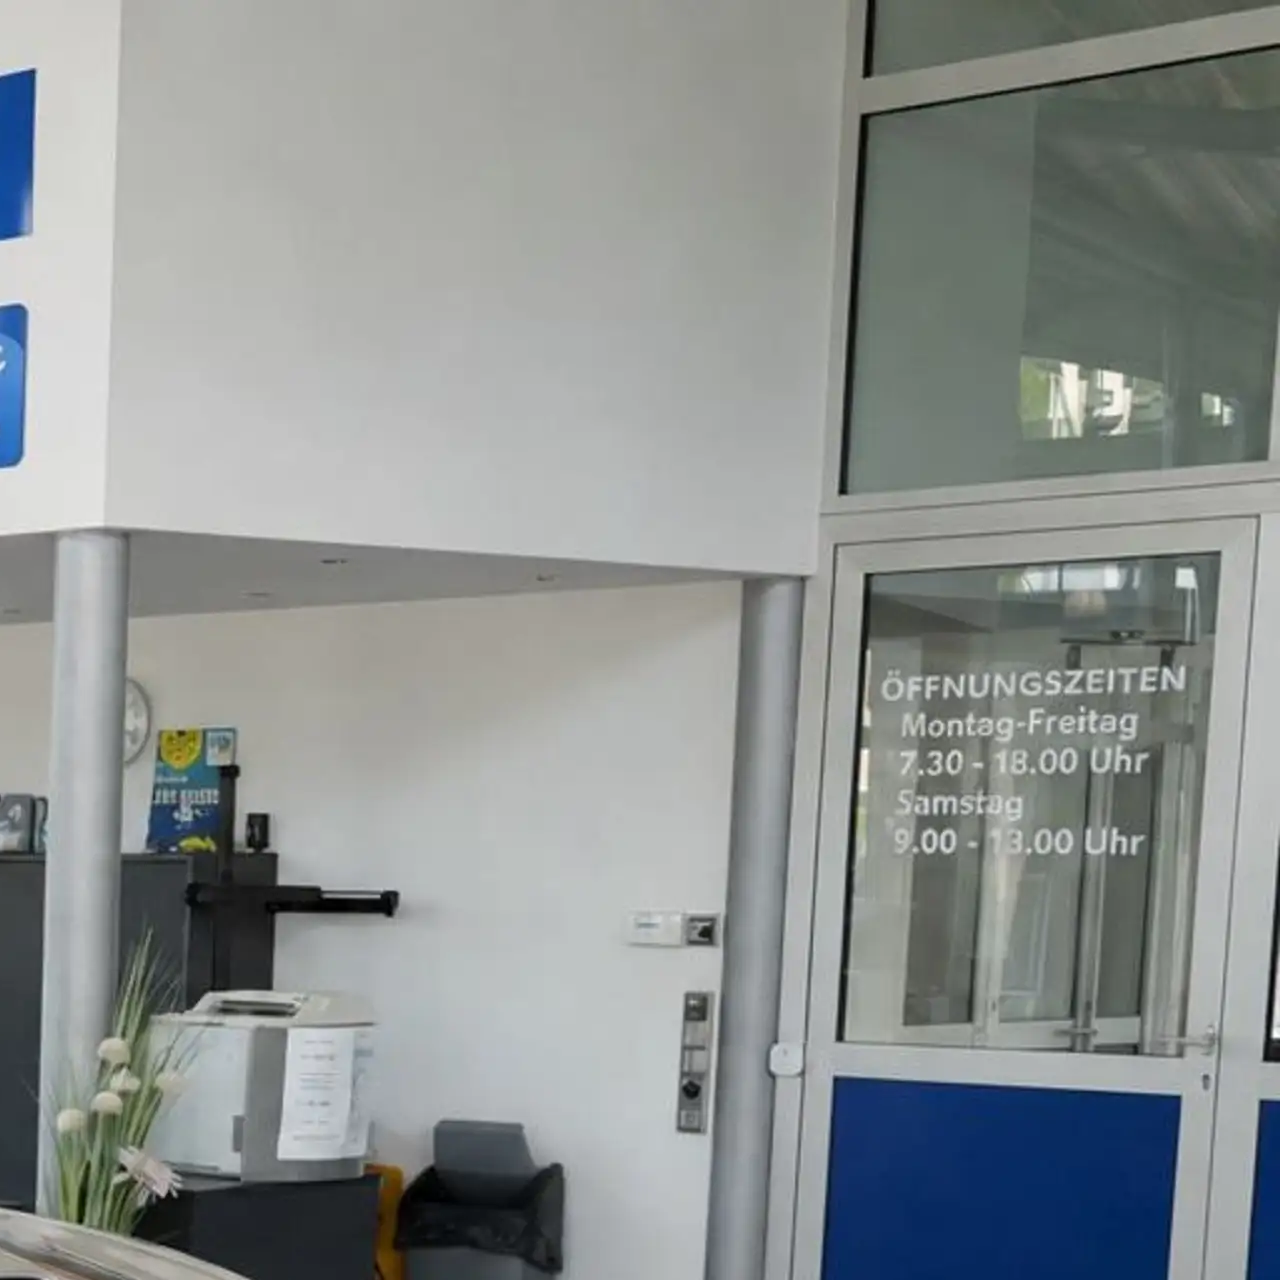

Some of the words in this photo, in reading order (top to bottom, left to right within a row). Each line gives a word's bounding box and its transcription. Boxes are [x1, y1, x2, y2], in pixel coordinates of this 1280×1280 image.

[880, 665, 1186, 702] ÖFFNUNGSZEITEN
[901, 706, 1139, 742] Montag-Freitag
[898, 749, 964, 776] 7.30
[994, 748, 1079, 775] 18.00
[1089, 746, 1150, 774] Uhr
[894, 789, 1024, 821] Samstag
[892, 827, 958, 855] 9.00
[990, 827, 1075, 855] 13.00
[1084, 826, 1147, 855] Uhr
